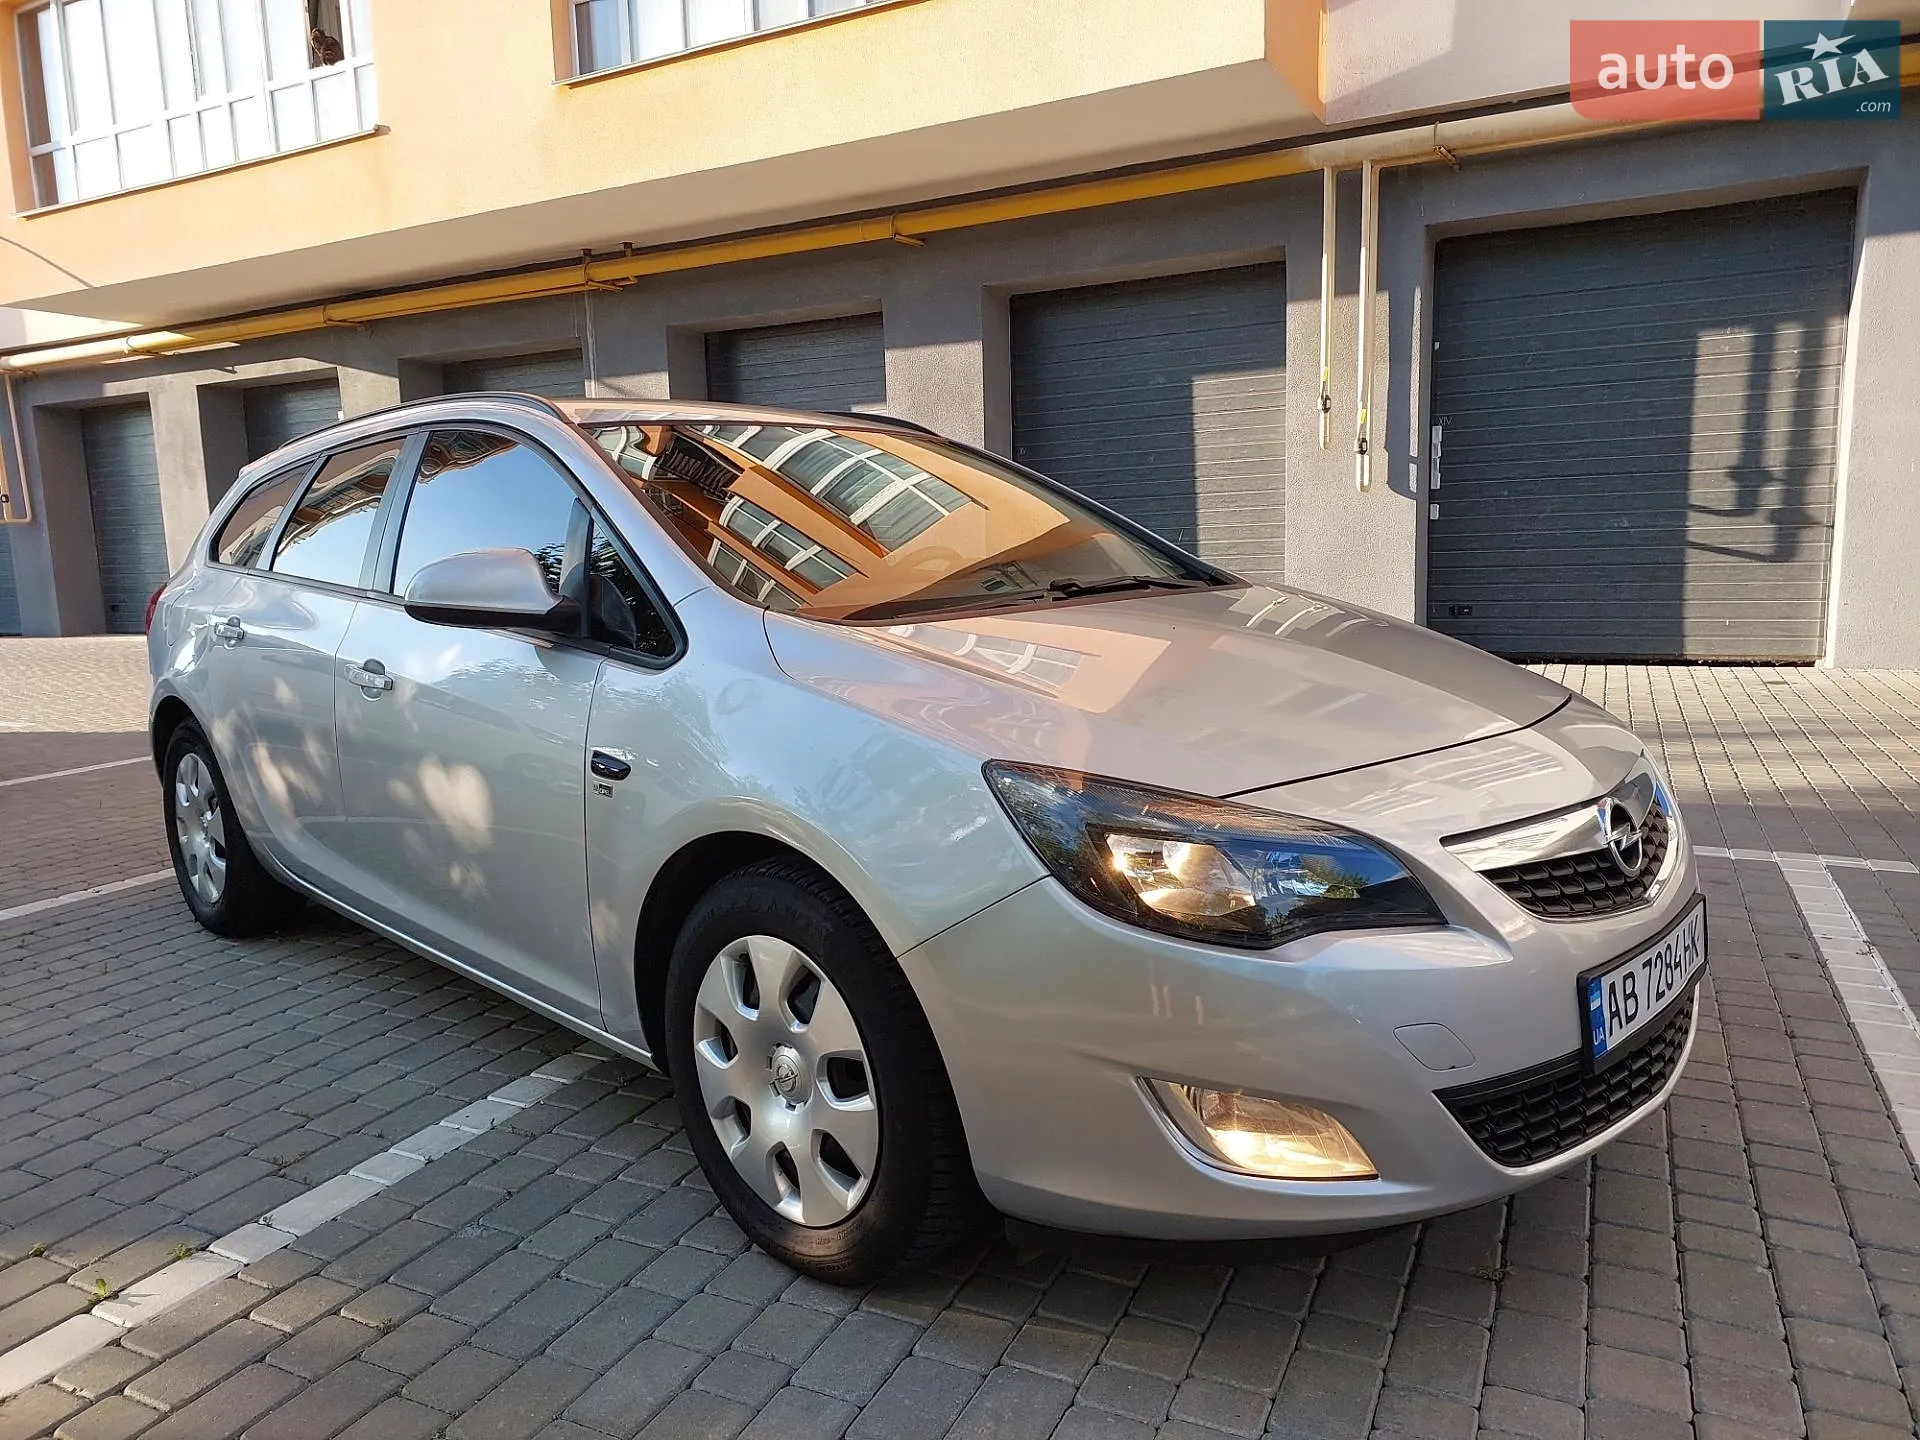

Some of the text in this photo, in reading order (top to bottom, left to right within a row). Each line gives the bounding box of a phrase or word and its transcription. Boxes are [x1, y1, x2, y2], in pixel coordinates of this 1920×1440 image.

[1608, 971, 1638, 1037] AB
[1642, 932, 1683, 1010] 7284
[1592, 1026, 1605, 1045] UA
